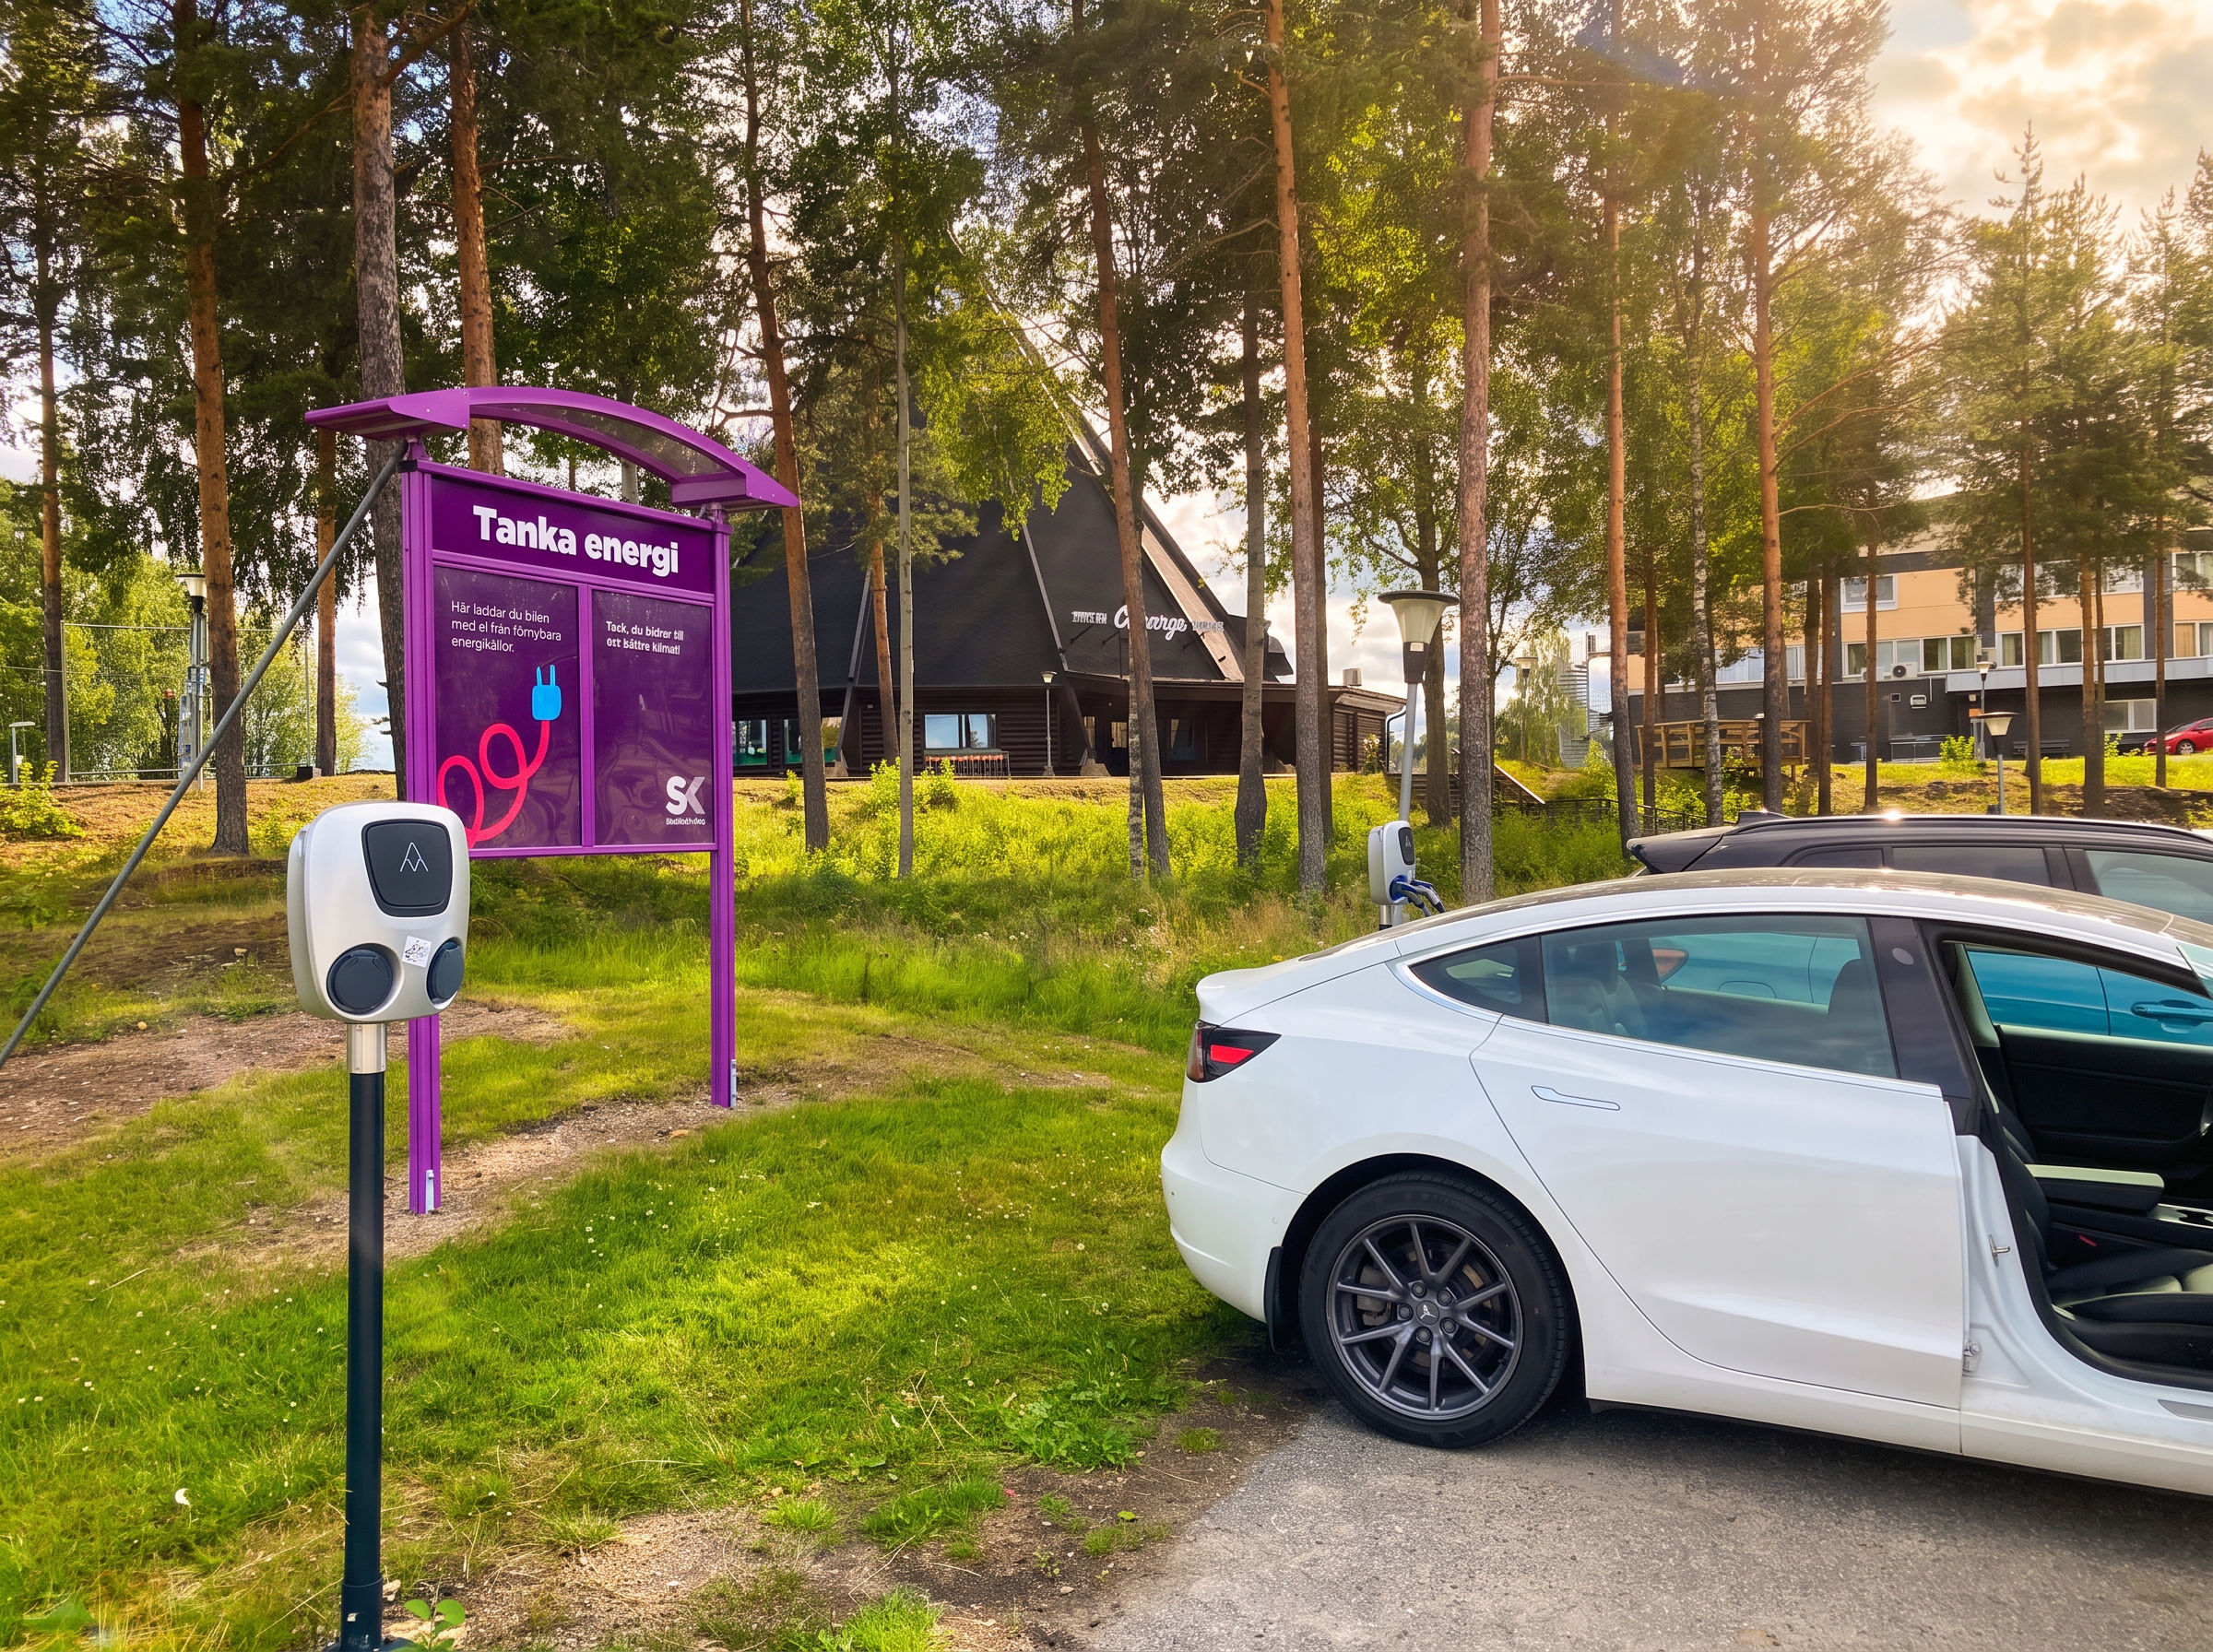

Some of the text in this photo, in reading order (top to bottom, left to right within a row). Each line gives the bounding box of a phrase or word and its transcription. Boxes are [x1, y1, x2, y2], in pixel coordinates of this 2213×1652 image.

[473, 505, 679, 577] Tanka energi
[451, 600, 550, 624] Här laddar du bilen
[451, 620, 562, 642] med el från förnybara
[631, 624, 644, 636] du
[451, 637, 515, 653] energikällor.
[666, 775, 706, 816] SK
